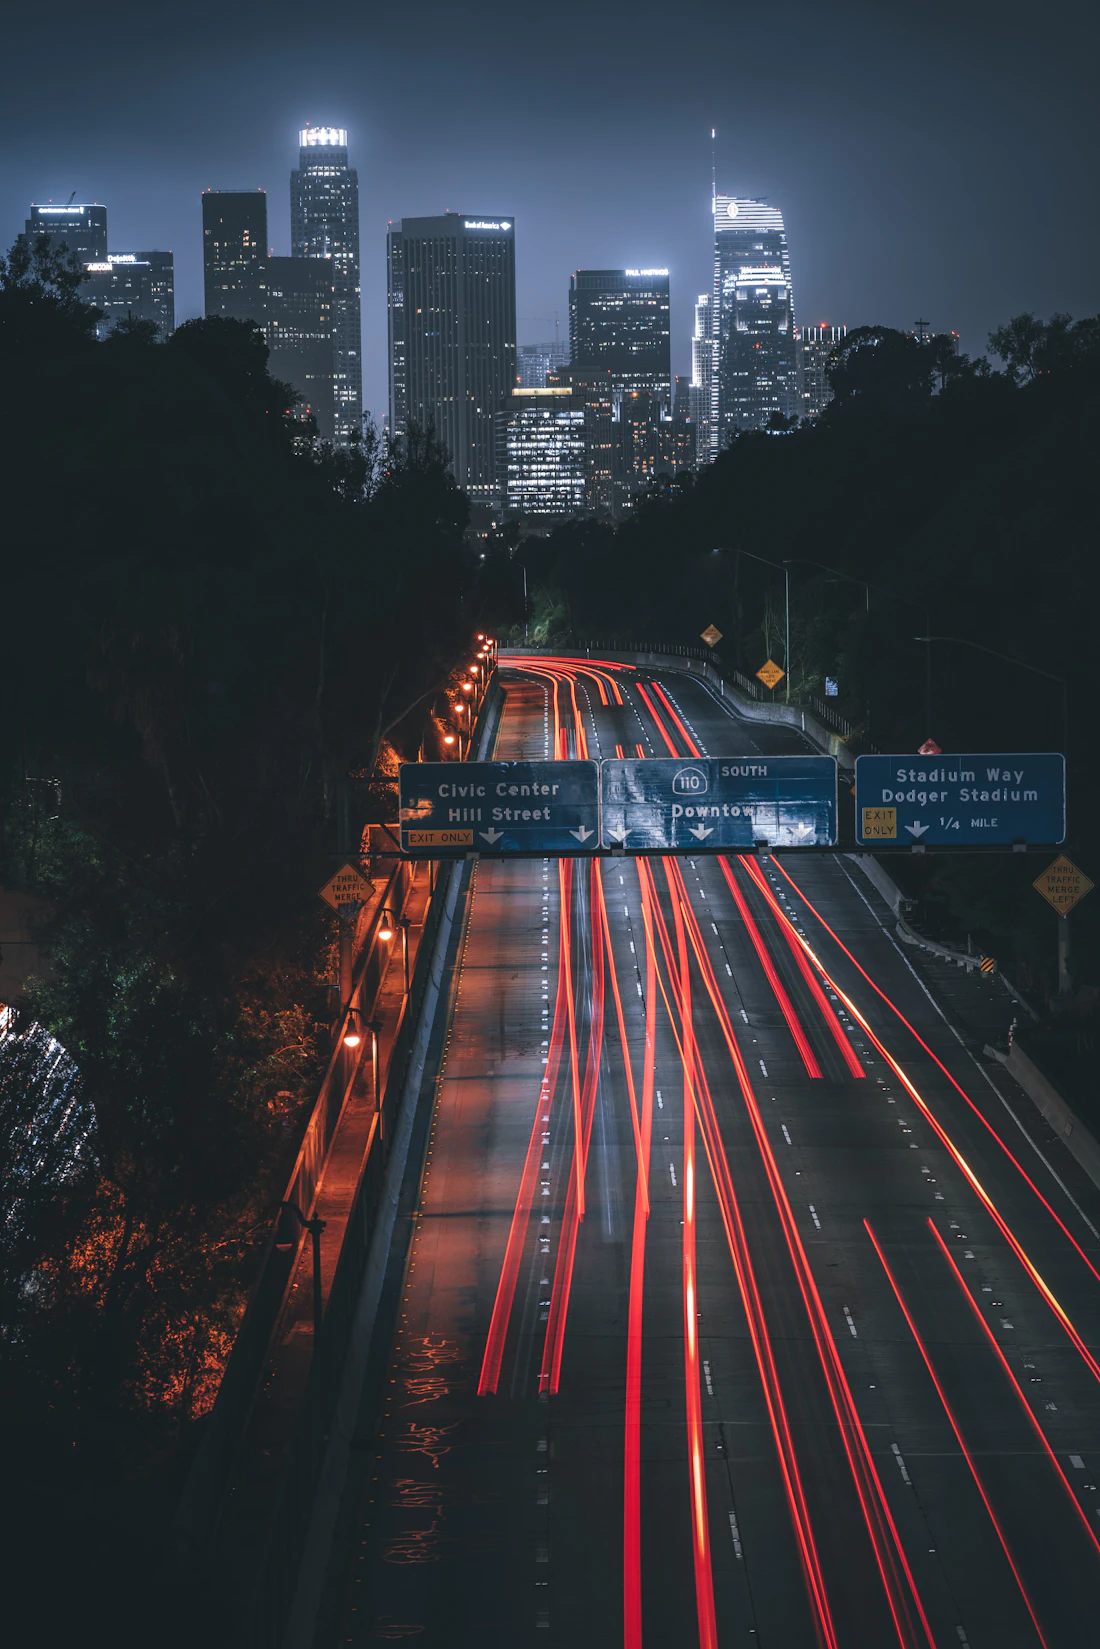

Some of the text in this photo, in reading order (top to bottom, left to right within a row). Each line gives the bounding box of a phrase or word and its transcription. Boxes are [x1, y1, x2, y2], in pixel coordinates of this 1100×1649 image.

[721, 765, 768, 777] SOUTH
[896, 768, 1025, 785] Stadium Way
[679, 776, 700, 790] 110
[438, 782, 560, 798] Civic Center
[882, 787, 1039, 806] Dodger Stadium
[448, 806, 551, 822] Hill Street
[671, 803, 768, 818] Downtown
[865, 810, 894, 821] EXIT
[970, 818, 998, 828] MILE
[864, 826, 895, 836] ONLY
[409, 832, 471, 843] EXIT ONLY
[1052, 866, 1074, 874] THRU
[1046, 875, 1081, 884] TRAFFIC
[331, 883, 365, 893] TRAFFIC
[1047, 885, 1080, 894] MERGE
[334, 892, 361, 900] MERGE
[1052, 896, 1075, 904] LEFT
